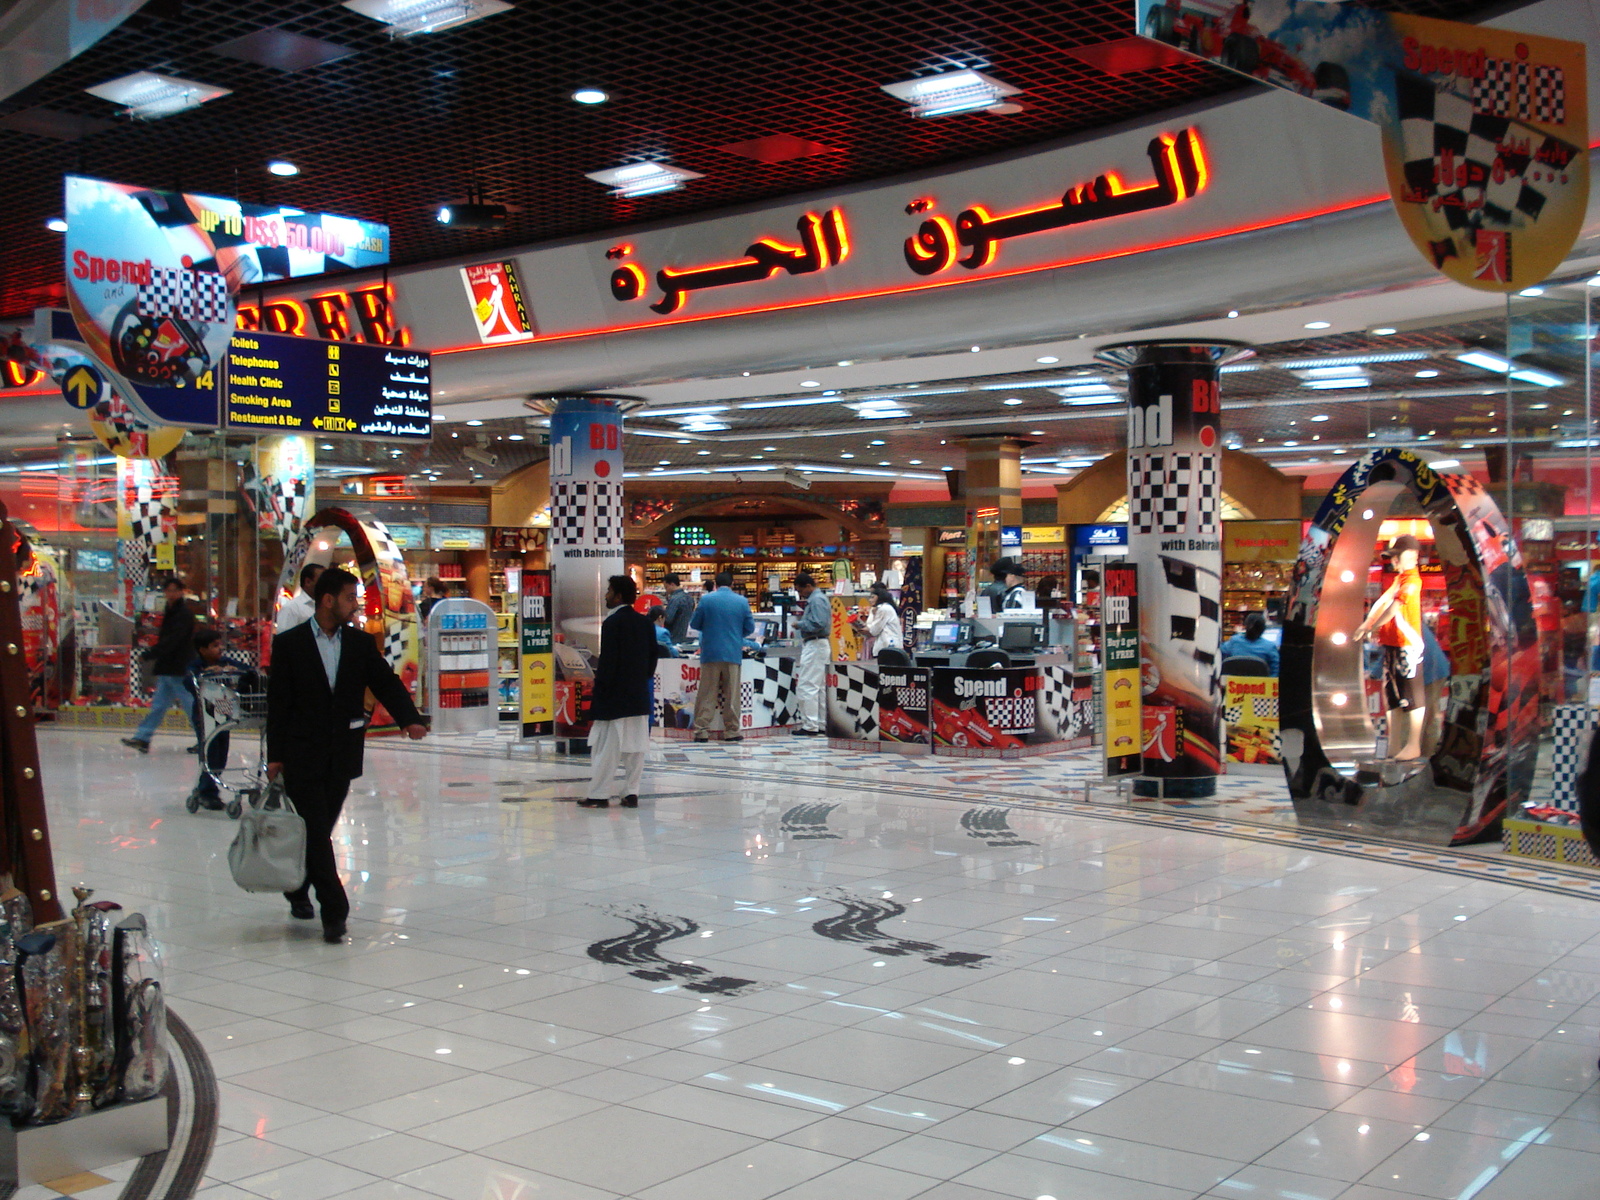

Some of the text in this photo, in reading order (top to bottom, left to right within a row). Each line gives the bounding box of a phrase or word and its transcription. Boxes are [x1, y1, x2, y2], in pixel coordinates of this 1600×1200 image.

[1403, 36, 1485, 79] Spend
[606, 126, 1210, 314] السوق الحرة
[201, 209, 220, 232] UP
[223, 216, 242, 236] TO
[286, 222, 345, 257] 50,000
[359, 237, 383, 253] CASH
[73, 250, 151, 285] Spend
[104, 285, 125, 300] and
[505, 264, 531, 331] BAHRAIN
[230, 337, 259, 350] Toilets
[230, 354, 279, 370] Telephones
[385, 352, 429, 368] دورات مياه
[230, 374, 283, 389] Health Clinic
[230, 393, 292, 408] Smoking Area
[382, 387, 429, 402] عيادة صحية
[374, 404, 429, 418] منطقة التدخين
[230, 411, 302, 427] Restaurant & Bar
[361, 419, 430, 435] المطعم والمقهى
[1161, 539, 1186, 551] with
[1234, 538, 1289, 547] TOBLERONE
[564, 549, 582, 558] with
[584, 548, 615, 558] Bahrain
[523, 595, 545, 618] OFFER
[1106, 596, 1130, 624] OFFER
[524, 628, 536, 638] Buy
[541, 628, 551, 638] get
[903, 609, 914, 645] JEWELS
[1034, 627, 1045, 642] 4
[532, 638, 549, 646] FREE
[1107, 637, 1120, 648] Buy
[1126, 637, 1137, 648] get
[1116, 650, 1135, 659] FREE
[681, 664, 701, 681] Spe
[880, 673, 907, 686] Spend
[954, 676, 1007, 697] Spend
[1228, 681, 1265, 695] Spend
[742, 714, 753, 727] 60
